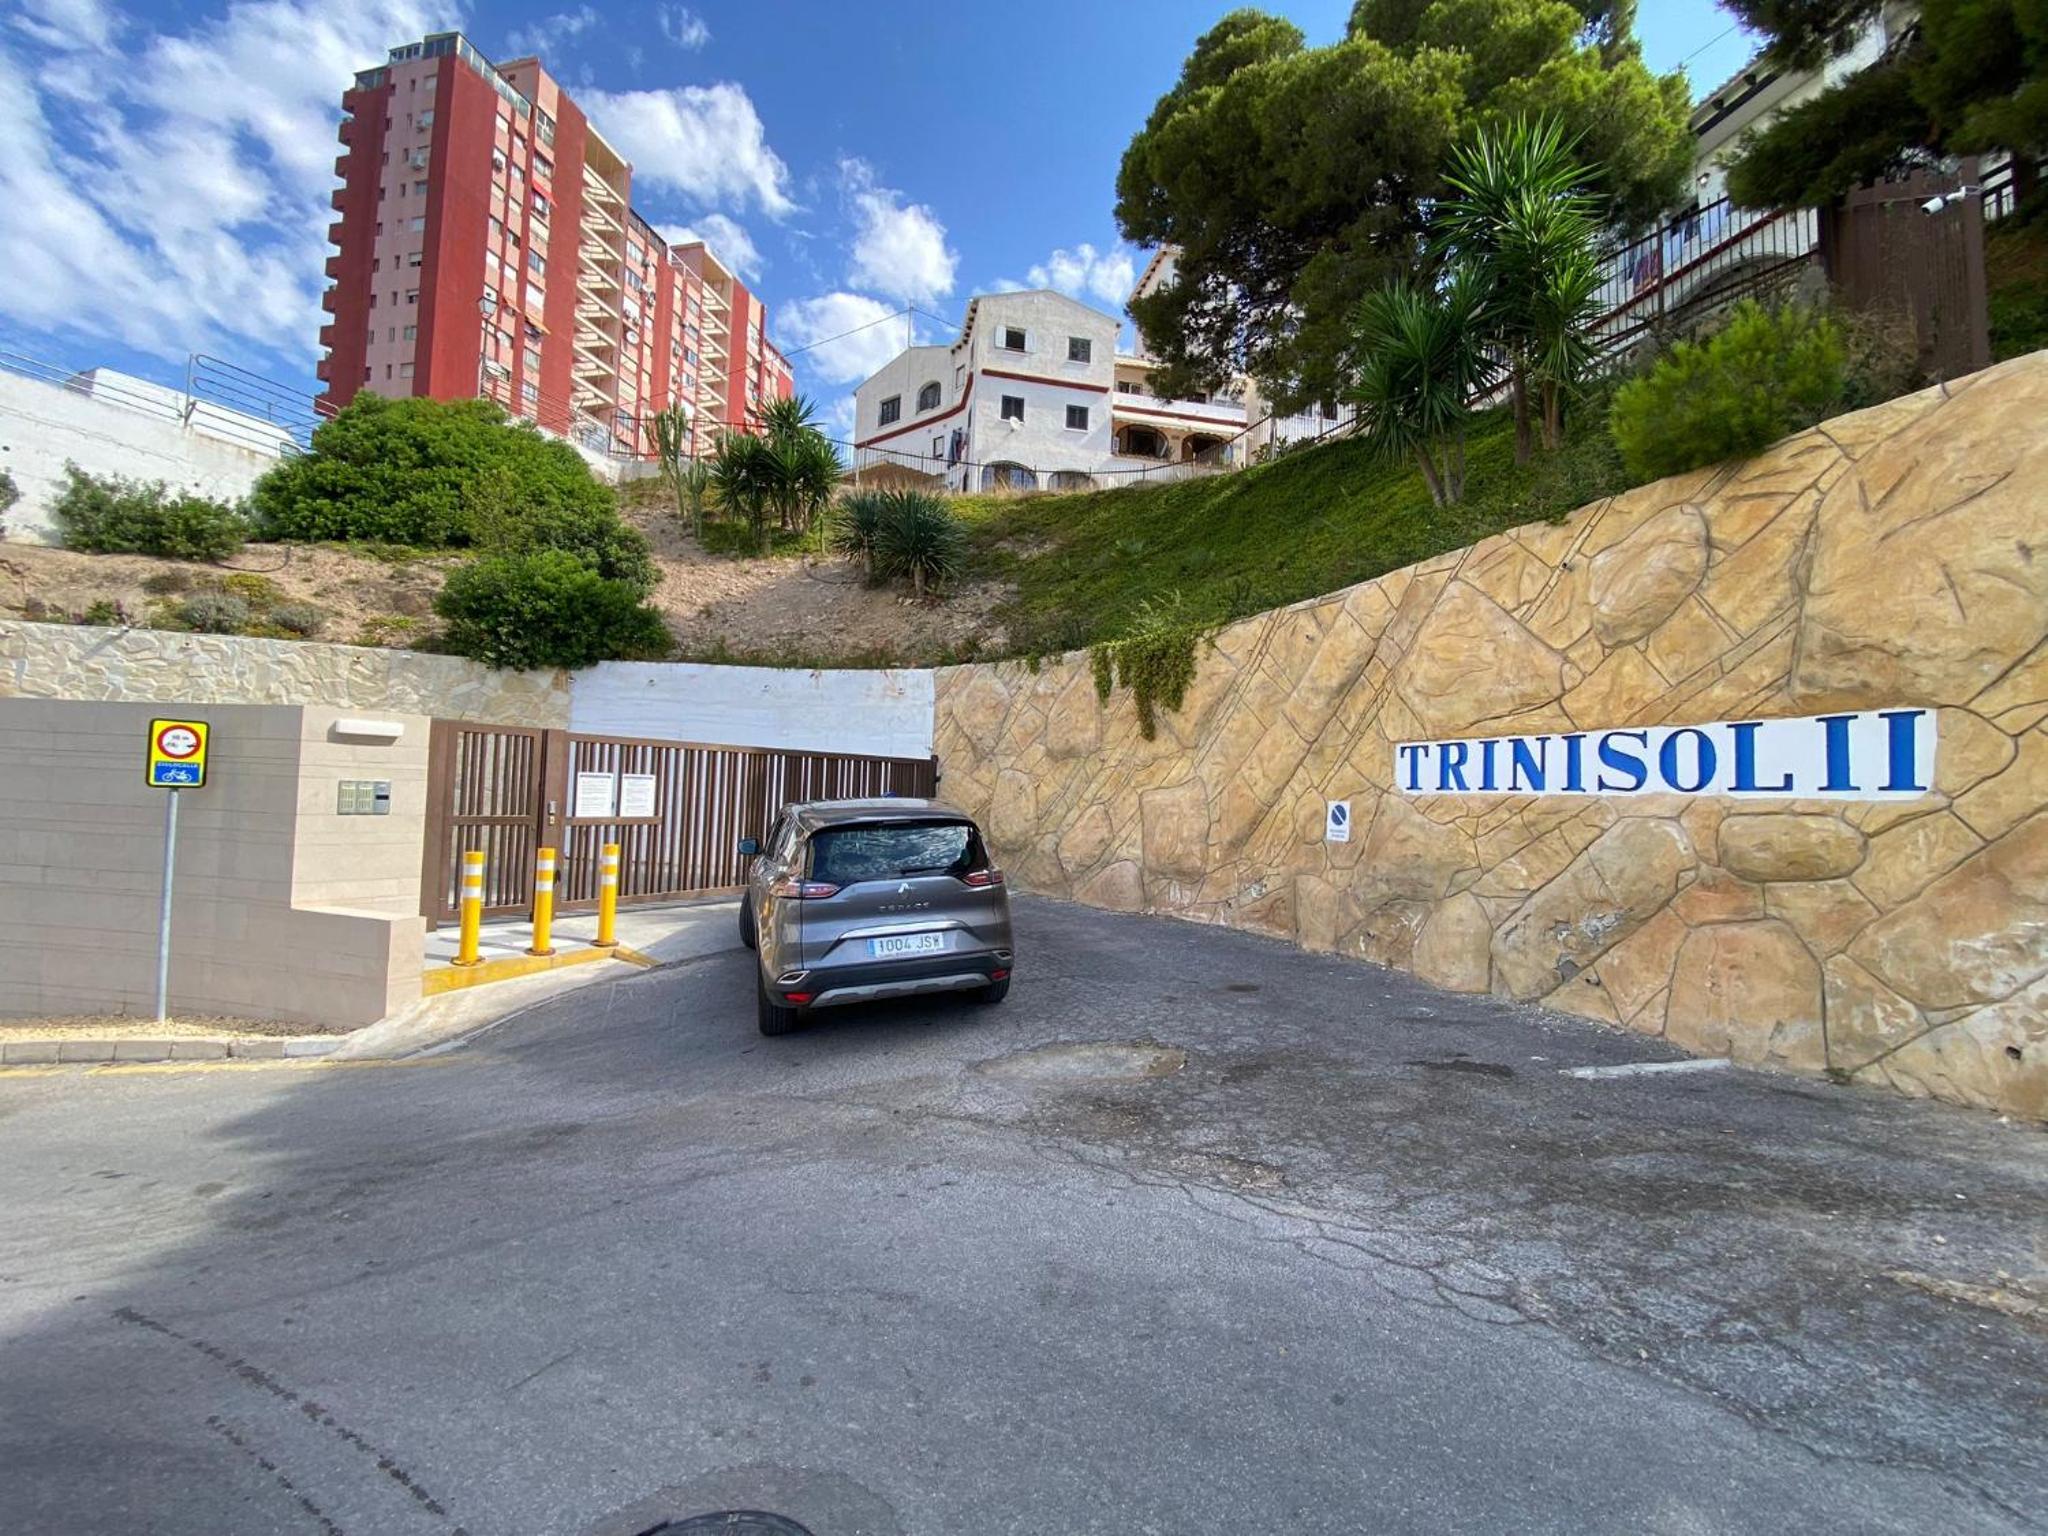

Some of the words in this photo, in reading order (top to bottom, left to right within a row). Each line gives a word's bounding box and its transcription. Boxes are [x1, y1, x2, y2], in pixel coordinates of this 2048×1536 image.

[1400, 721, 1794, 792] TRINISOL
[880, 937, 911, 952] 1004
[917, 934, 940, 949] JSW
